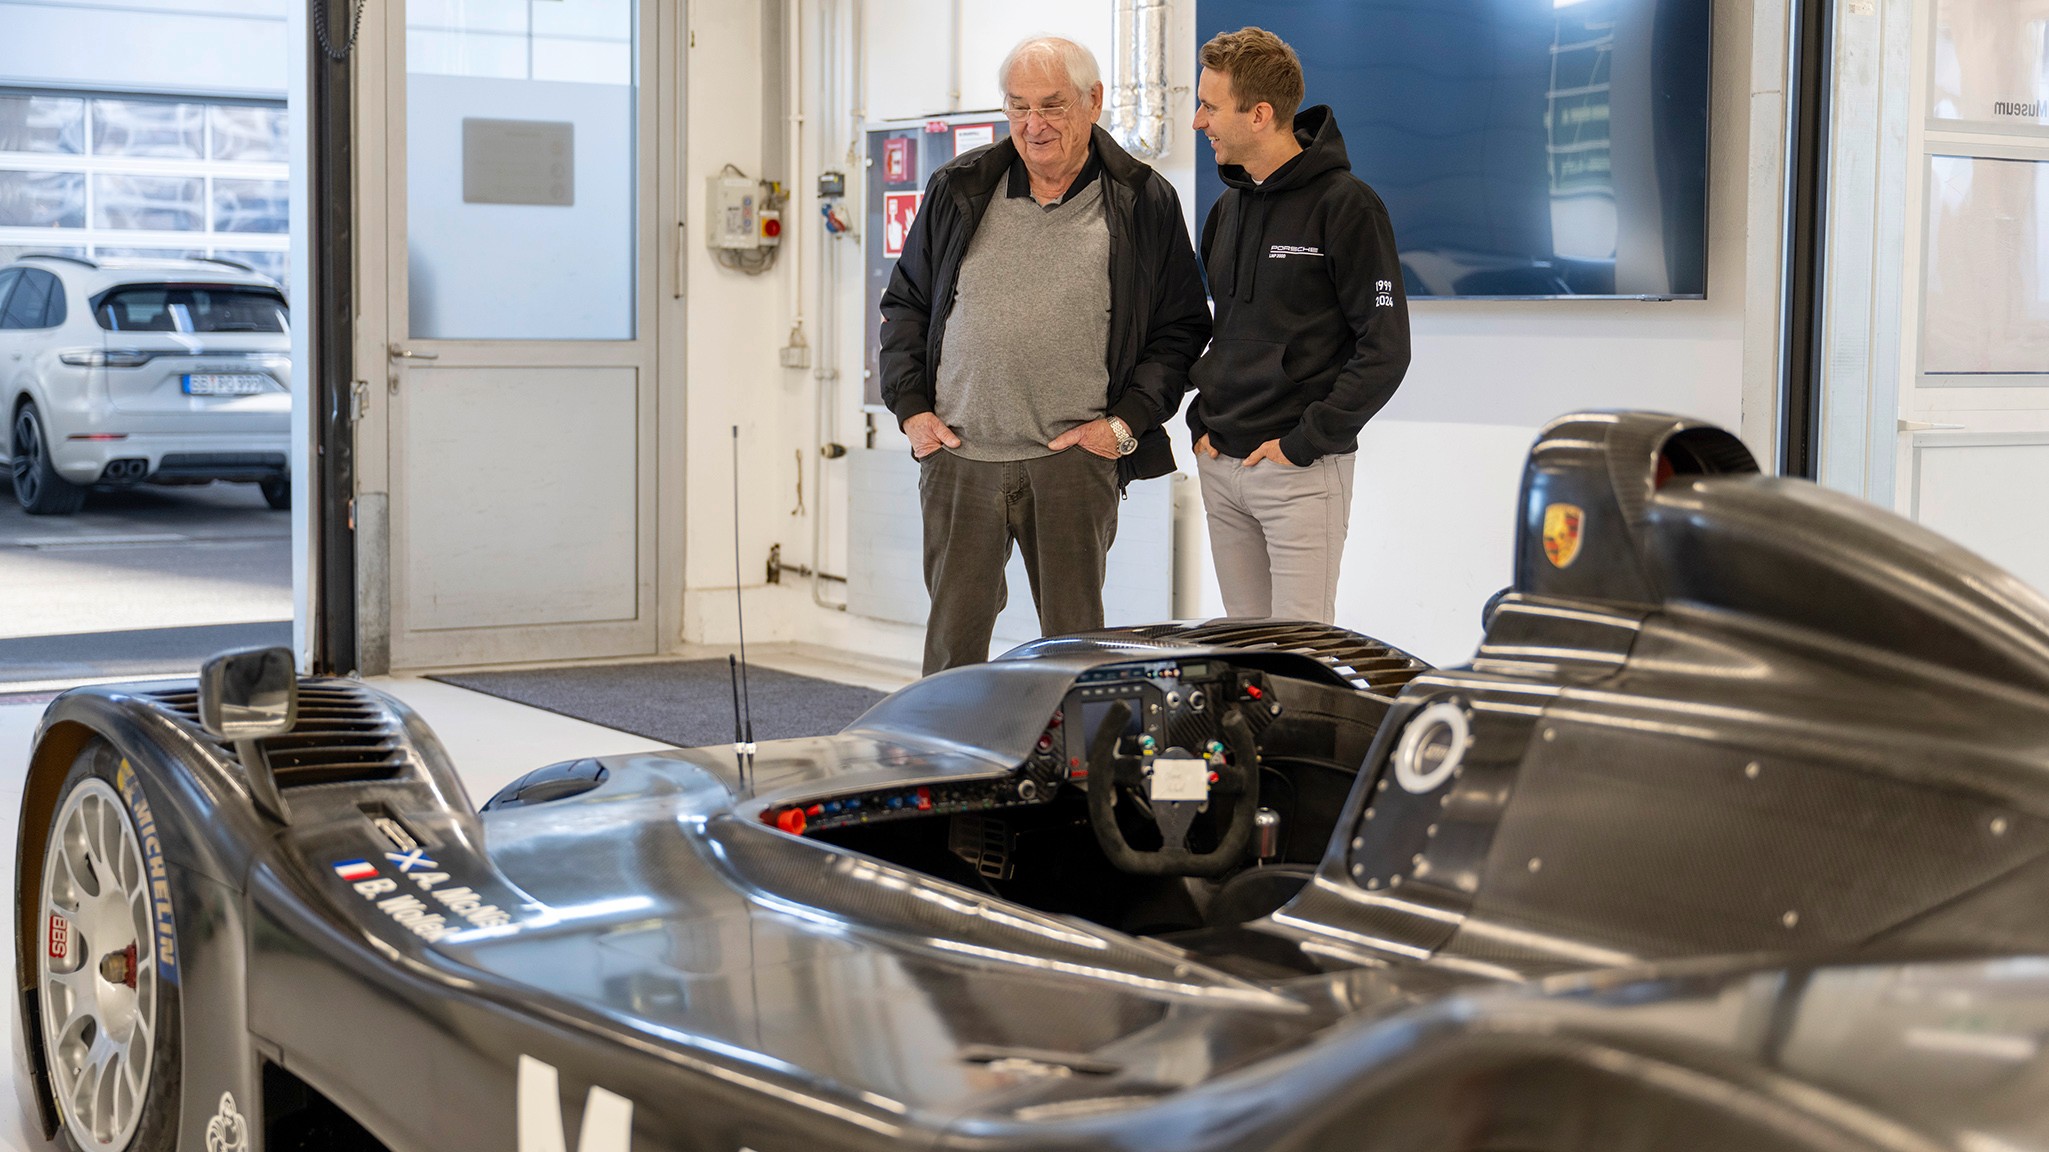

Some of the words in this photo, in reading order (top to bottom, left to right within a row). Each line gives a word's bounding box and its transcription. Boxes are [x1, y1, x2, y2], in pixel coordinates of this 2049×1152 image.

[1270, 245, 1319, 253] PORSCHE
[1375, 280, 1392, 291] 1999
[1375, 295, 1394, 307] 2024
[135, 800, 175, 966] MICHELIN
[353, 878, 398, 900] B.
[408, 872, 451, 891] A.
[431, 887, 514, 932] McNis
[52, 916, 67, 957] BBS
